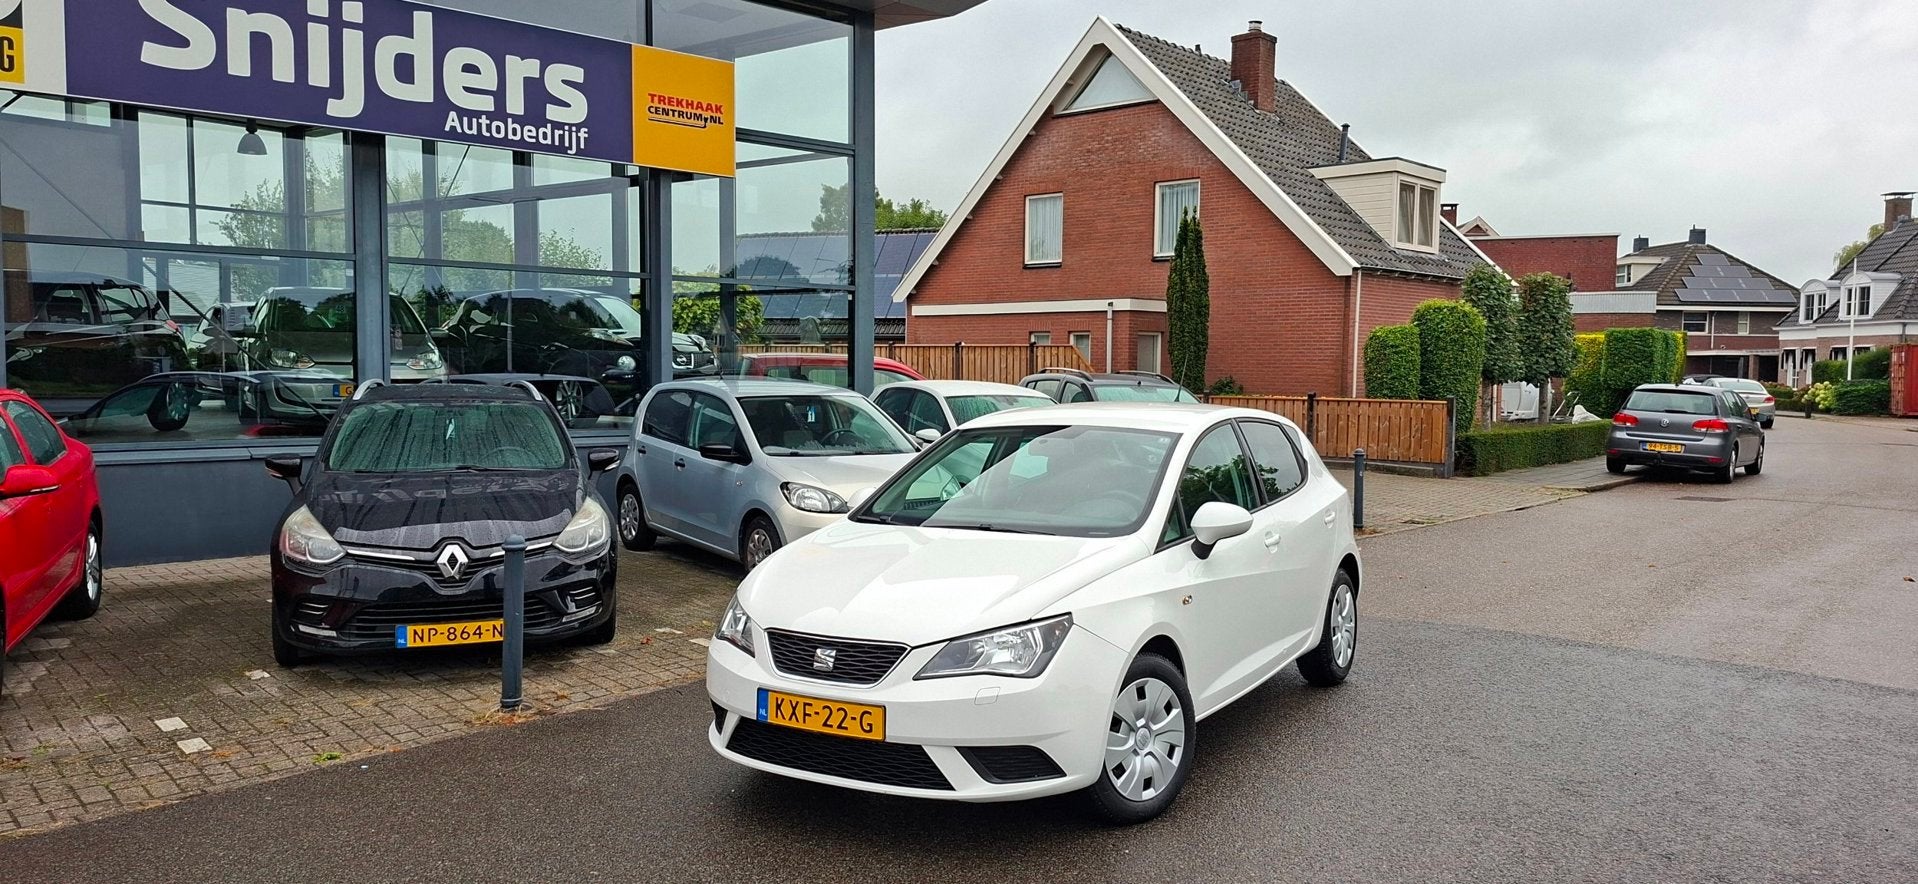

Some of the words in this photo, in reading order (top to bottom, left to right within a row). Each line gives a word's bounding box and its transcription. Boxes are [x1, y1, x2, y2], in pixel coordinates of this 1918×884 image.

[138, 0, 588, 124] Snijders
[648, 92, 724, 115] TREKHAAK
[444, 111, 588, 154] Autobedrijf
[412, 623, 504, 644] NP-864-N
[775, 696, 873, 734] KXF-22-G
